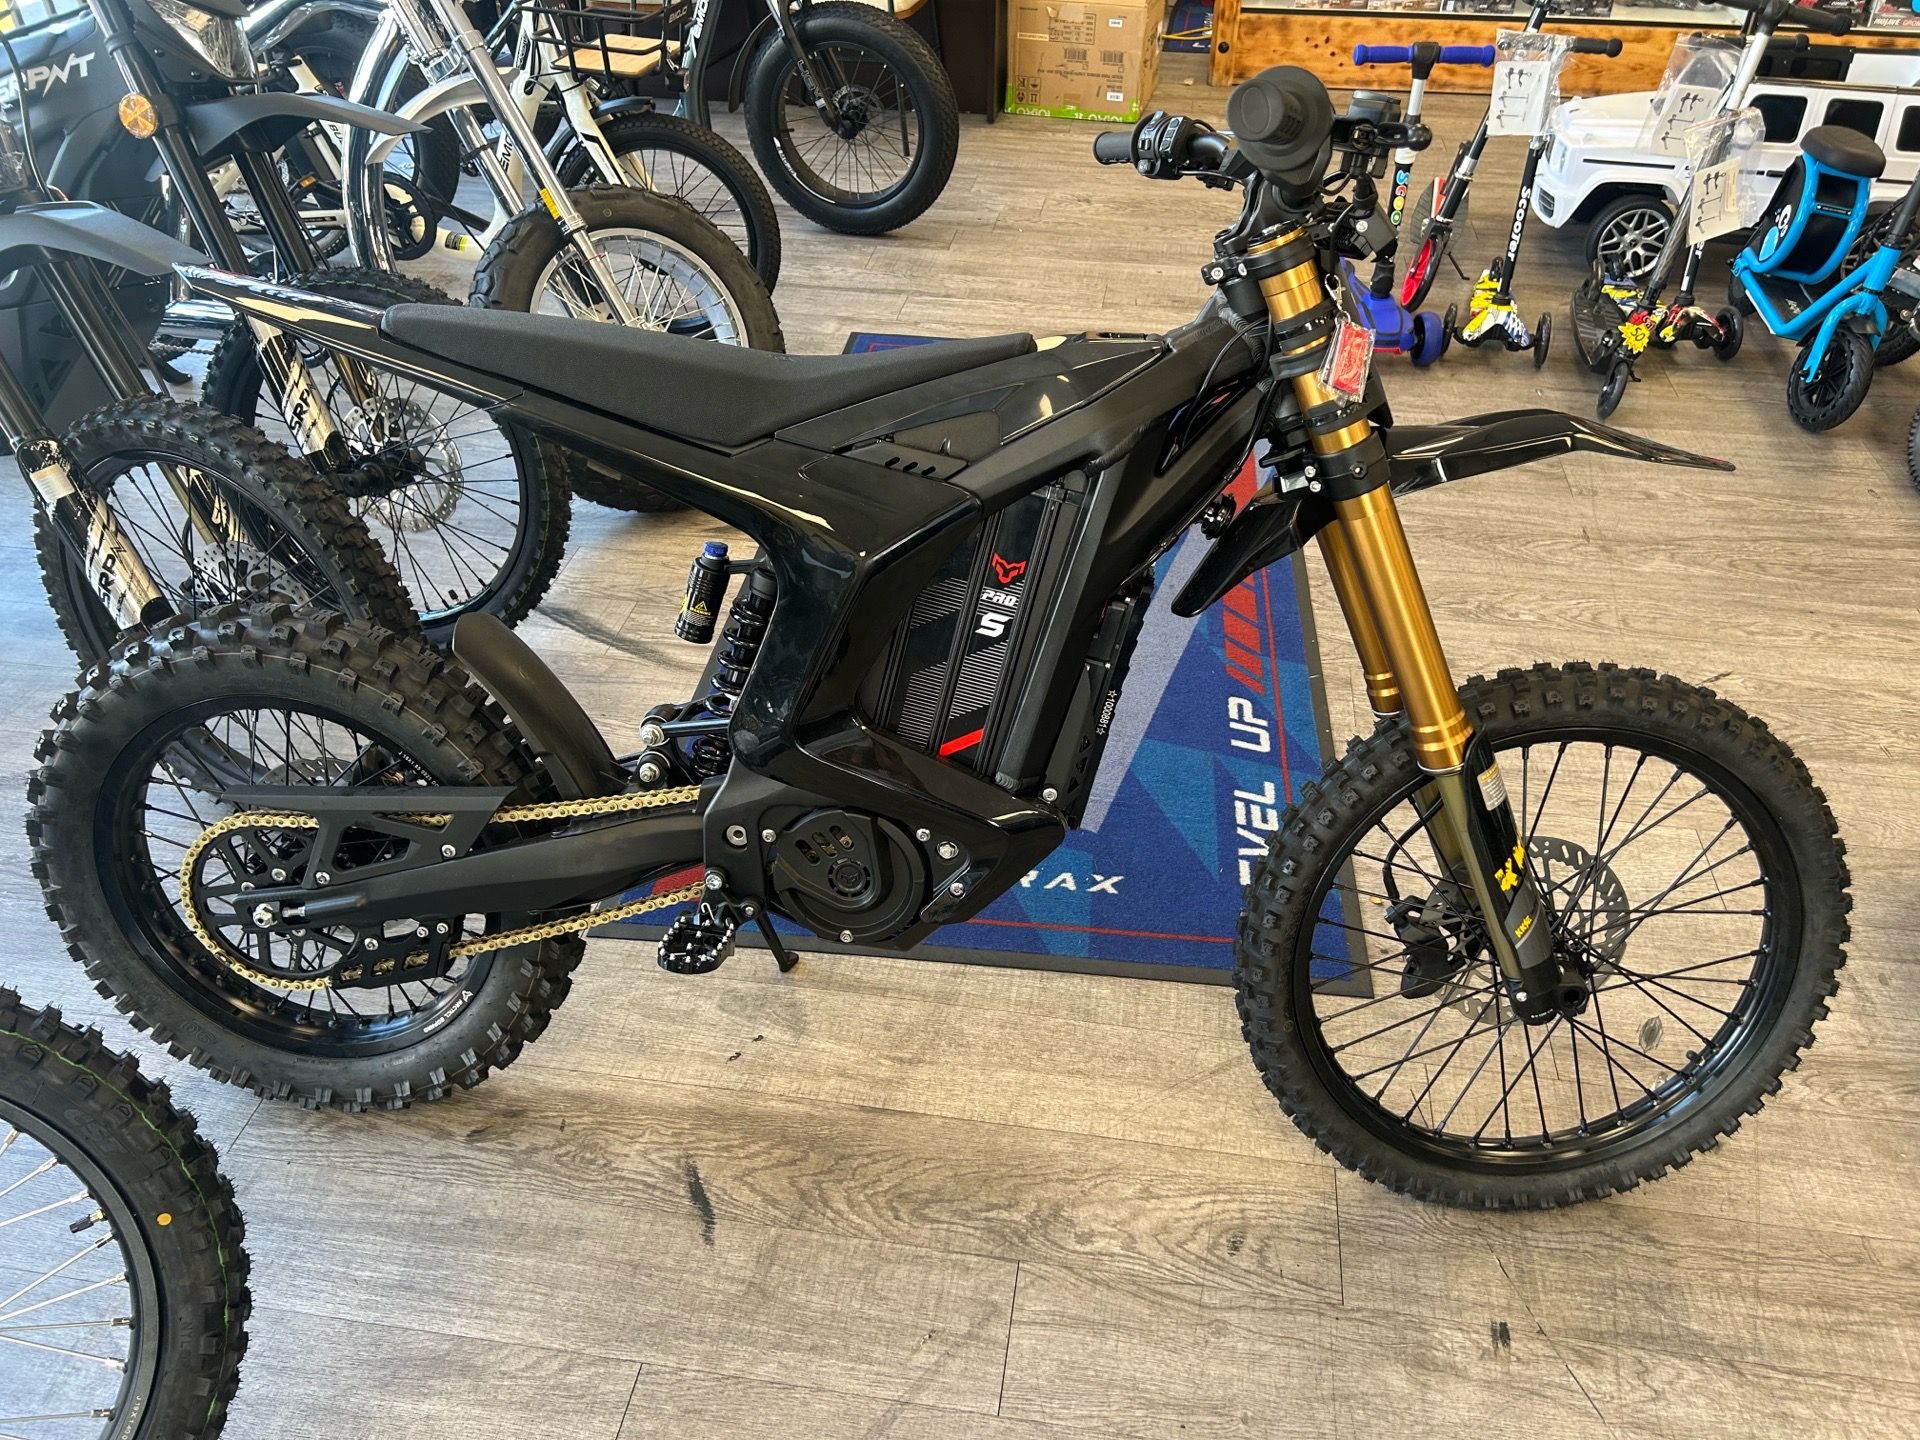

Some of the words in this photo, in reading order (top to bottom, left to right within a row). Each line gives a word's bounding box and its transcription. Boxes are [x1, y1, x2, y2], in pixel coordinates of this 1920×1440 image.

[980, 589, 1019, 608] PRO
[974, 611, 1014, 638] S
[1227, 696, 1271, 753] UP
